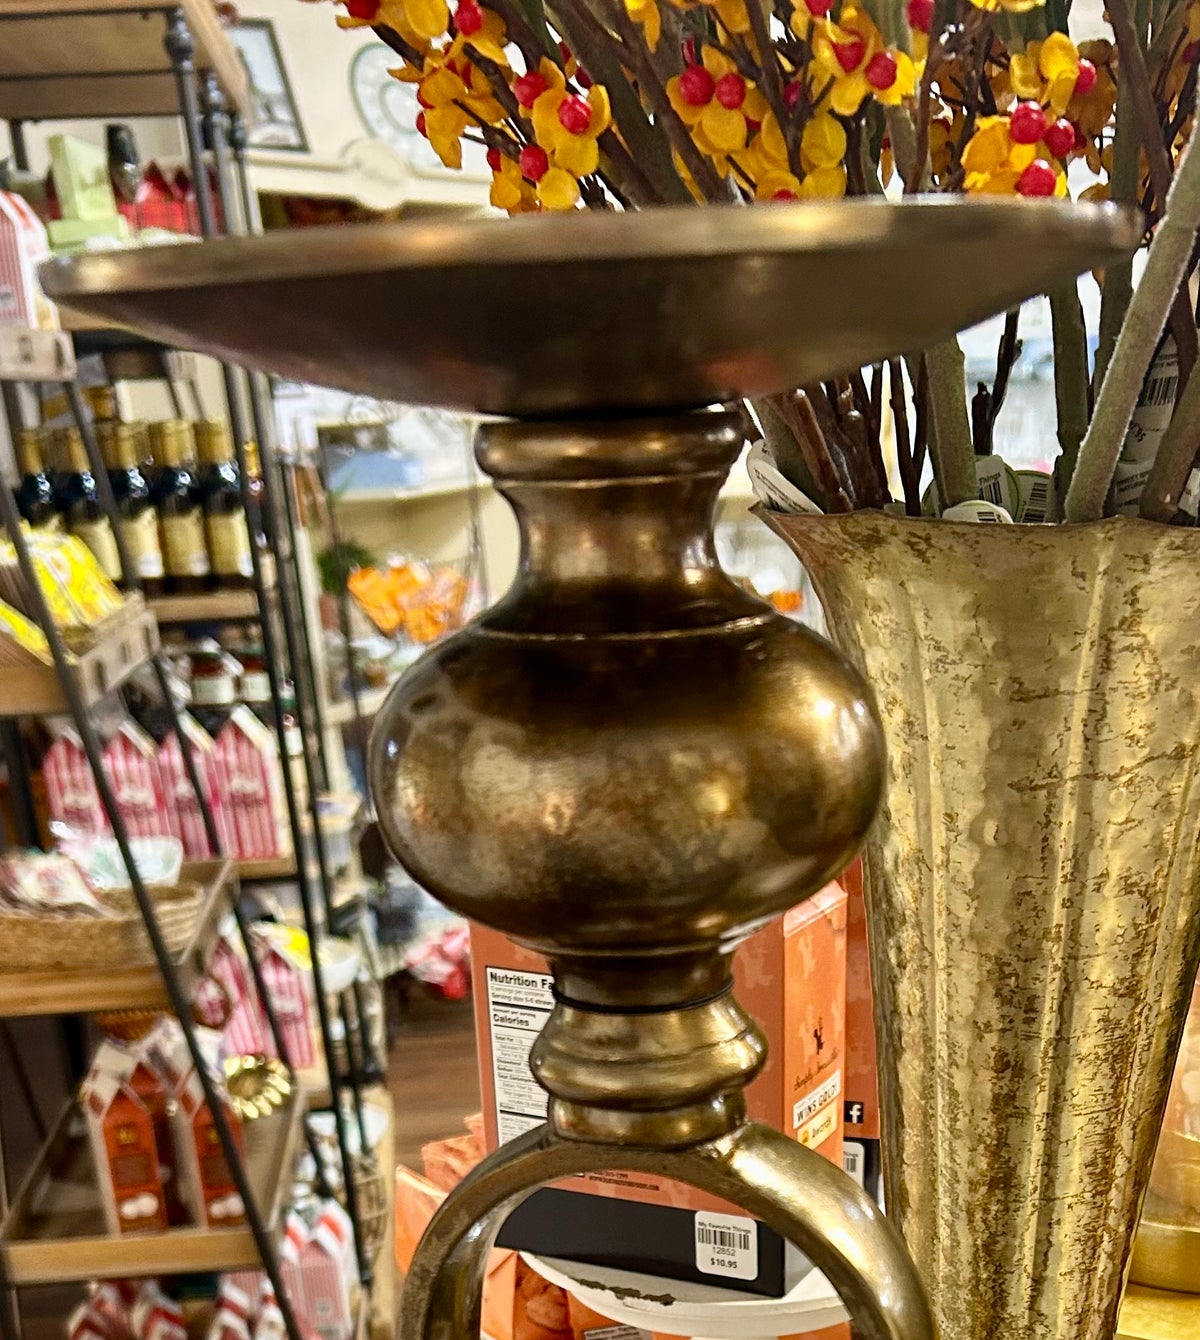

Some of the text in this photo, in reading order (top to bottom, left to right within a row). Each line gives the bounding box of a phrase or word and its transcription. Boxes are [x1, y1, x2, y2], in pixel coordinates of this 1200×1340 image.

[490, 971, 553, 990] Nutrition Fa
[493, 1014, 529, 1027] Calories
[710, 1258, 738, 1269] $10.95
